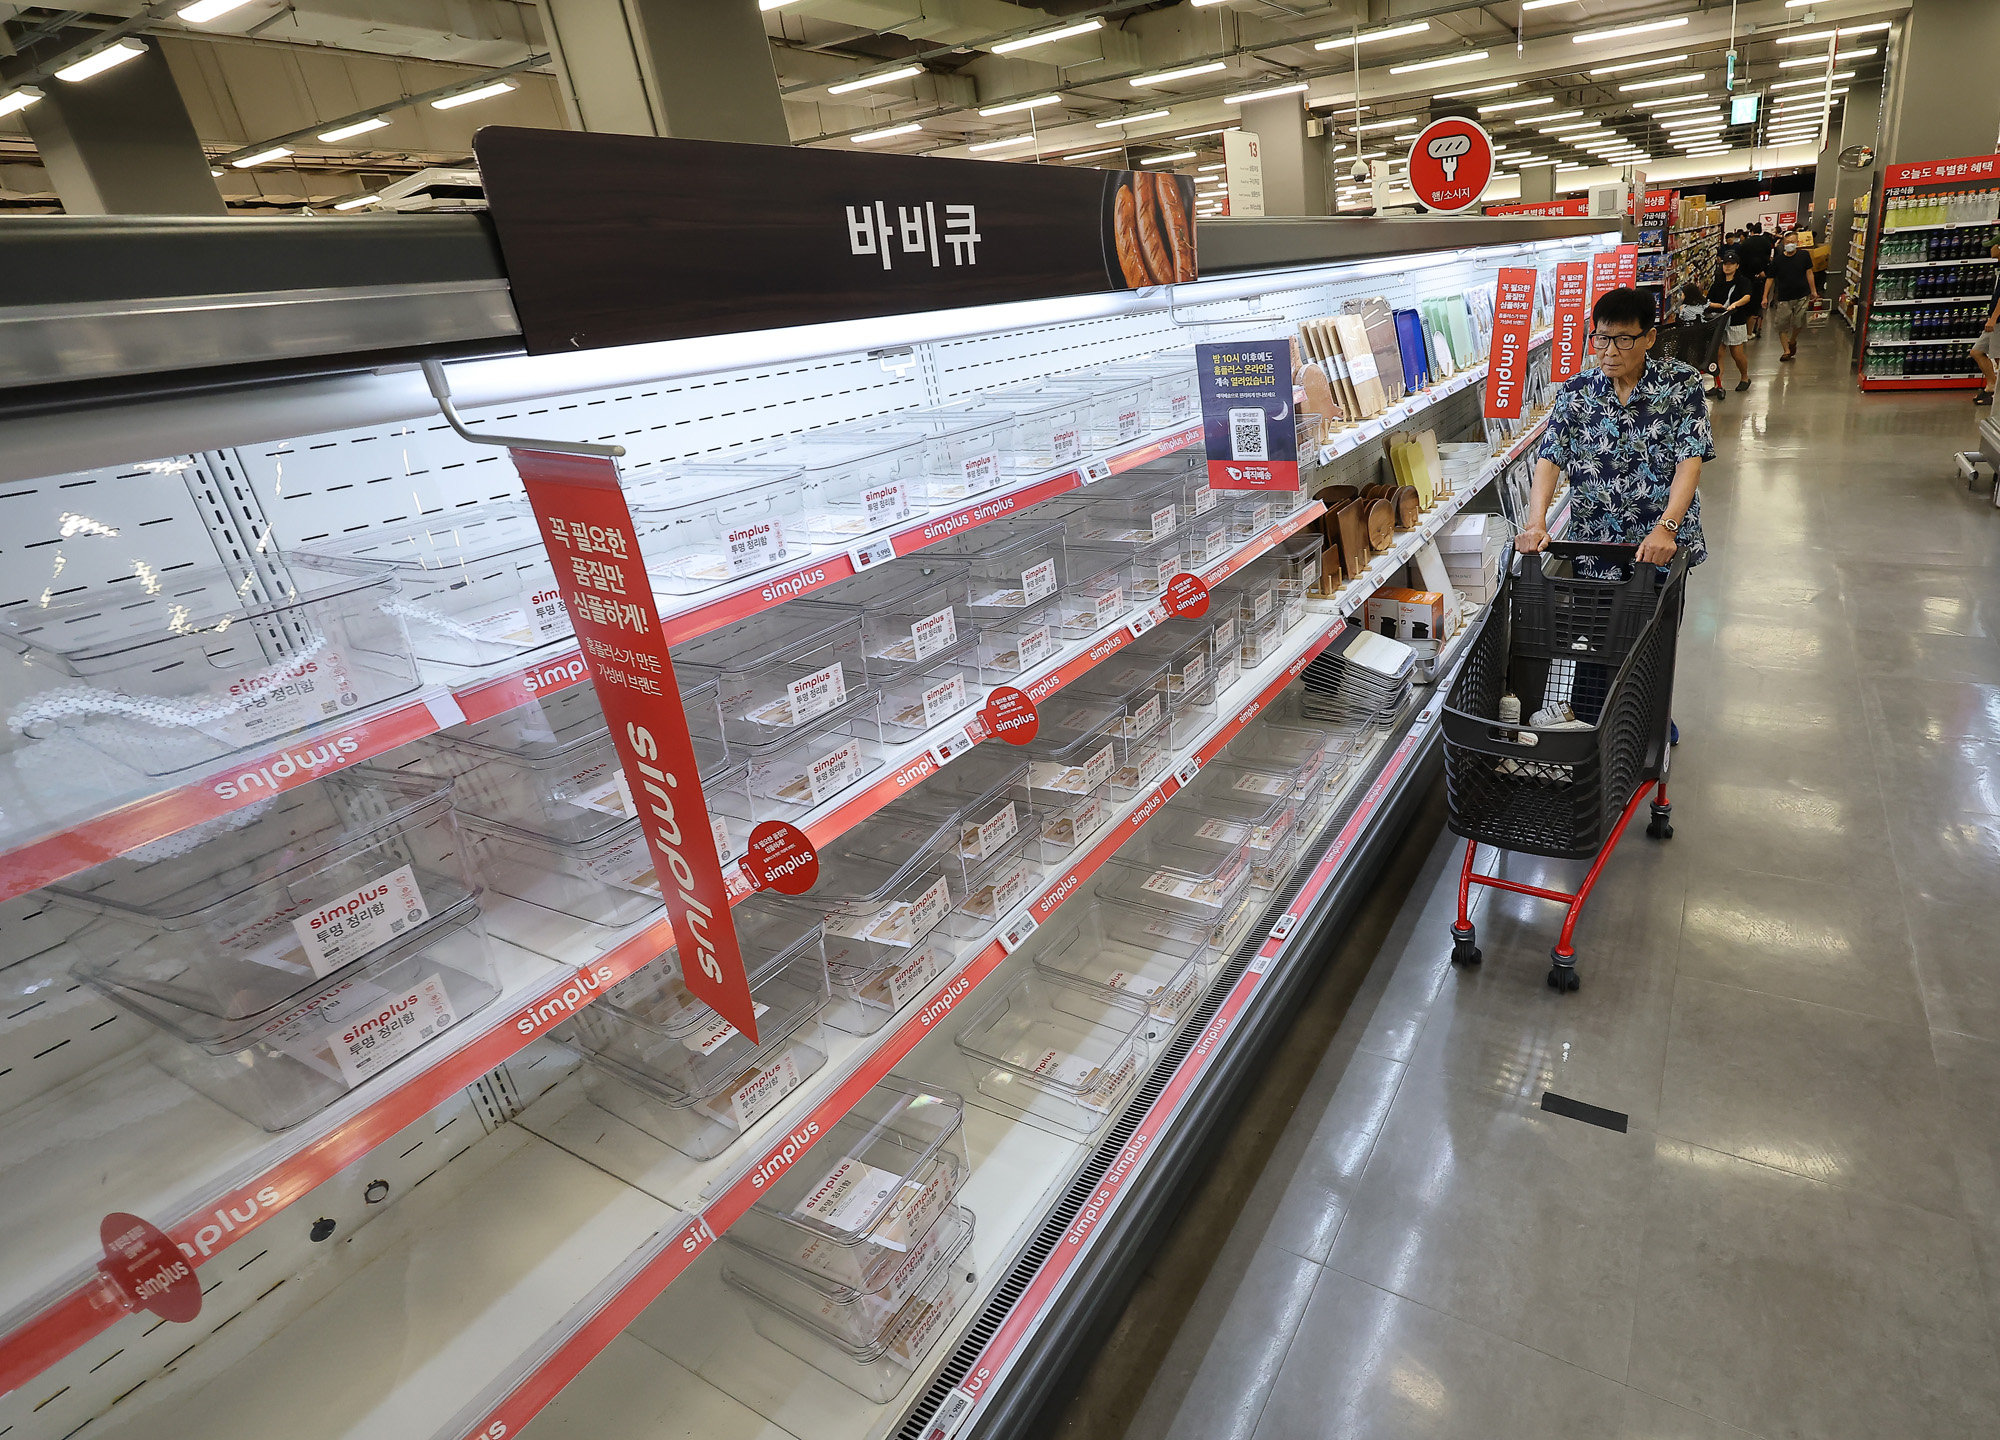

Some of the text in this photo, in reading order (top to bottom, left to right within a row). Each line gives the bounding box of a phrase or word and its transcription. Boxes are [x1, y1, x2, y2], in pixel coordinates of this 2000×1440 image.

[1249, 142, 1258, 157] 13
[1899, 160, 1994, 180] 오늘도 특별한 혜택
[1431, 187, 1470, 202] 햄/소시지
[1885, 186, 1914, 196] 가공식품
[845, 201, 982, 270] 바비큐
[1502, 284, 1531, 292] 꼭 필요한
[1566, 274, 1584, 282] 필요한
[1500, 301, 1529, 310] 심플하게!
[1505, 292, 1526, 301] 품질만
[1558, 314, 1577, 374] simplus
[1212, 352, 1274, 364] 밤 10시 이후에도
[1214, 364, 1274, 376] 홈플러스 온라인은
[1215, 375, 1275, 387] 계속 열려있습니다
[1495, 333, 1520, 408] simplus
[1054, 430, 1074, 442] simplus
[1158, 436, 1184, 454] simplus
[965, 455, 991, 470] simplus
[1243, 471, 1272, 480] 매직배송
[865, 485, 898, 502] simplus
[867, 497, 896, 513] 투명 정리함
[924, 497, 1014, 540] simplus simplus
[1281, 521, 1299, 536] simplus
[548, 516, 628, 560] 꼭 필요한
[728, 522, 770, 543] simplus
[731, 536, 768, 555] 투명 정리함
[570, 556, 626, 596] 품질만
[761, 568, 825, 602] simplus
[1025, 565, 1047, 581] simplus
[1207, 564, 1230, 583] simplus
[536, 603, 556, 619] 투명
[1098, 592, 1117, 607] simplus
[1176, 591, 1207, 611] simplus
[573, 590, 650, 635] 심플하게!
[916, 614, 945, 634] simplus
[917, 625, 943, 642] 투명 정리함
[1021, 631, 1043, 648] simplus
[1327, 622, 1343, 639] simplus
[584, 636, 662, 674] 홈플러스가 만든
[1089, 636, 1122, 661] simplus
[1289, 657, 1307, 676] simplus
[270, 678, 314, 702] 정리함
[597, 662, 663, 697] 가성비 브랜드
[793, 670, 831, 694] simplus
[926, 681, 955, 702] simplus
[796, 683, 828, 705] 투명 정리함
[928, 691, 953, 710] 투명 정리함
[996, 712, 1036, 732] simplus
[1238, 701, 1260, 724] simplus
[214, 736, 360, 799] simplus
[813, 748, 848, 774] simplus
[815, 761, 847, 784] 투명 정리함
[1086, 751, 1107, 770] simplus
[1366, 784, 1383, 803] simplus
[1074, 804, 1096, 825] simplus
[1131, 795, 1161, 826] simplus
[982, 811, 1008, 835] simplus
[626, 721, 723, 984] simplus
[1324, 840, 1345, 863] simplus
[764, 851, 813, 882] simplus
[995, 872, 1020, 898] simplus
[1040, 873, 1078, 913] simplus
[310, 884, 389, 930] simplus
[909, 887, 938, 917] simplus
[911, 899, 937, 926] 투명 정리함
[316, 901, 385, 944] 투명 정리함
[894, 954, 925, 985] simplus
[896, 965, 923, 992] 투명 정리함
[517, 965, 614, 1035] simplus
[920, 976, 970, 1026] simplus
[343, 994, 419, 1044] simplus
[350, 1034, 375, 1056] 투명
[378, 1010, 416, 1039] 정리함
[1197, 1017, 1227, 1056] simplus
[740, 1063, 781, 1101] simplus
[741, 1075, 779, 1110] 투명 정리함
[751, 1120, 821, 1188] simplus
[1109, 1133, 1148, 1185] simplus
[806, 1163, 850, 1209] simplus
[818, 1179, 851, 1214] 투명 정리함
[906, 1178, 939, 1220] simplus
[1068, 1189, 1110, 1245] simplus
[894, 1241, 928, 1284] simplus
[135, 1261, 189, 1300] simplus
[911, 1300, 943, 1343] simplus
